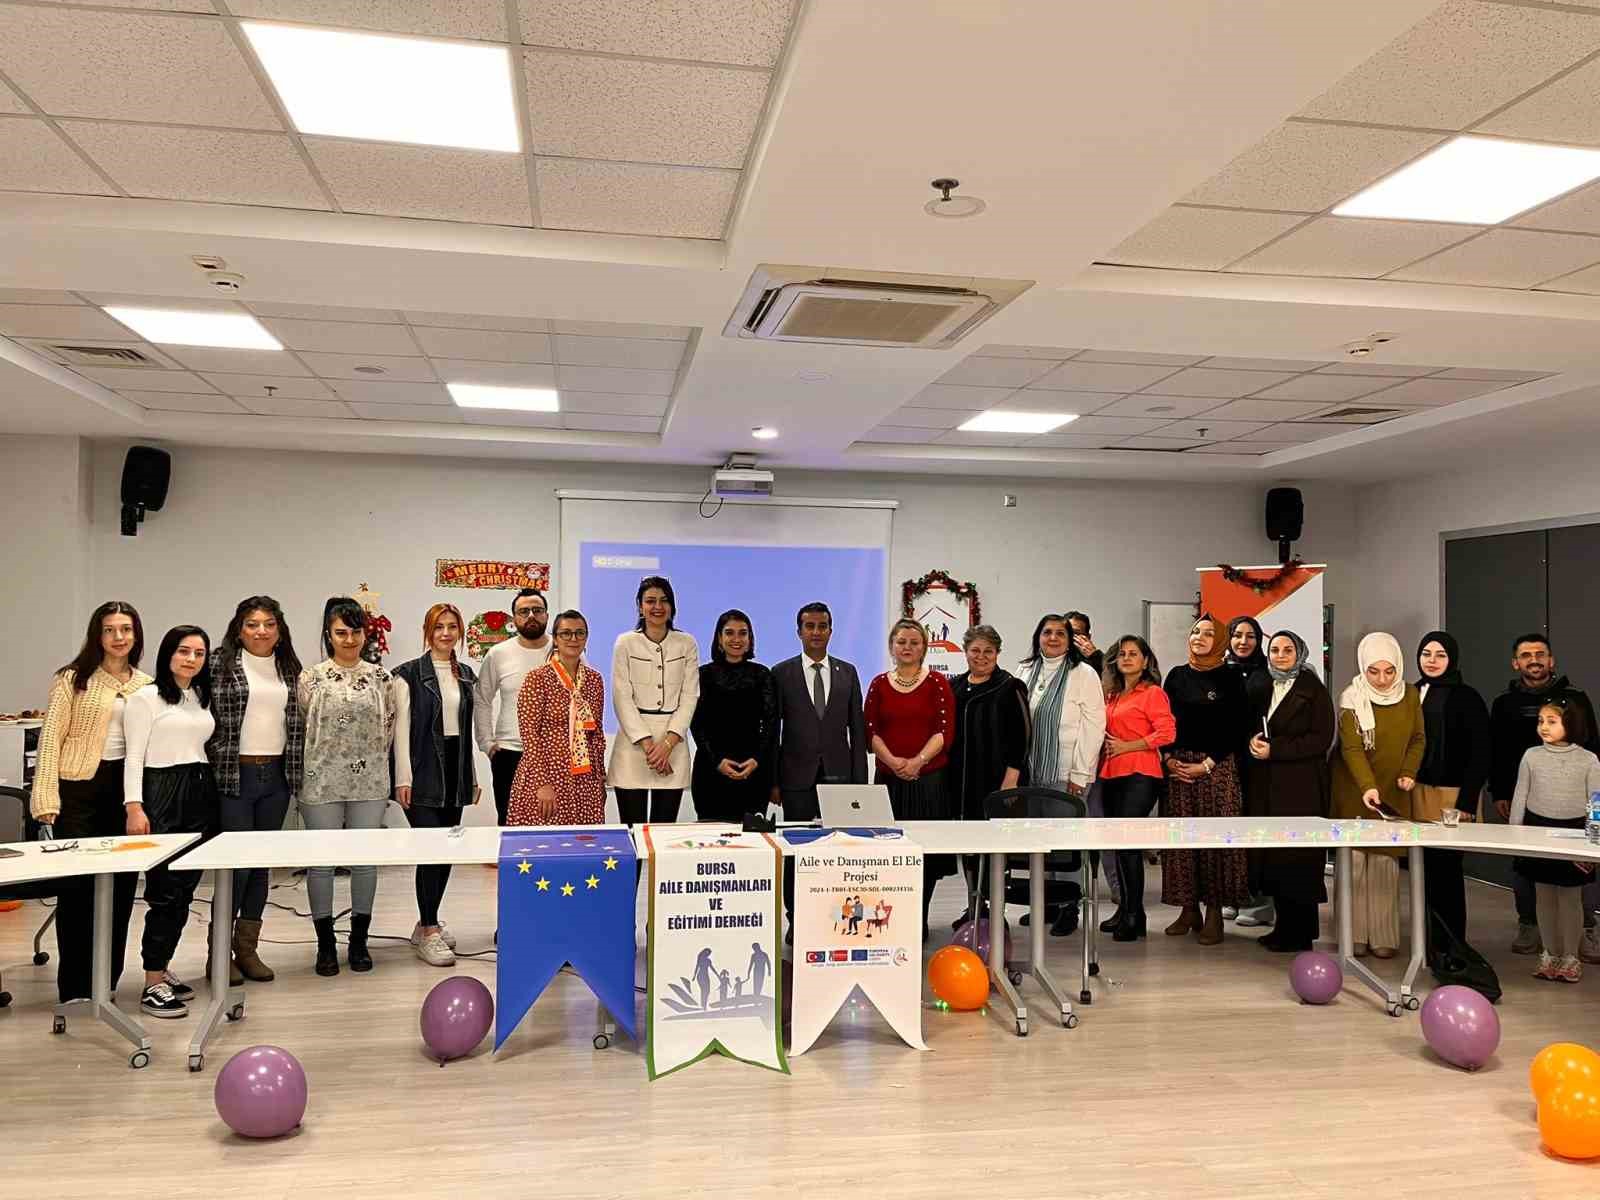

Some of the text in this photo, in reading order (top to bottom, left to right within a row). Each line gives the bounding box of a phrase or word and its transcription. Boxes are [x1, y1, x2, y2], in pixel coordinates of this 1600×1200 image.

[454, 563, 506, 576] MERRY
[479, 574, 545, 588] CHRISTMAS
[697, 862, 736, 875] BURSA
[800, 856, 821, 866] Aile
[837, 856, 889, 868] Danışman
[892, 856, 903, 866] El
[905, 856, 921, 866] Ele
[843, 871, 879, 884] Projesi
[659, 879, 771, 895] AİLE DANIŞMANLARI
[709, 898, 723, 910] VE
[668, 912, 763, 930] EĞİTİMİ DERNEĞİ
